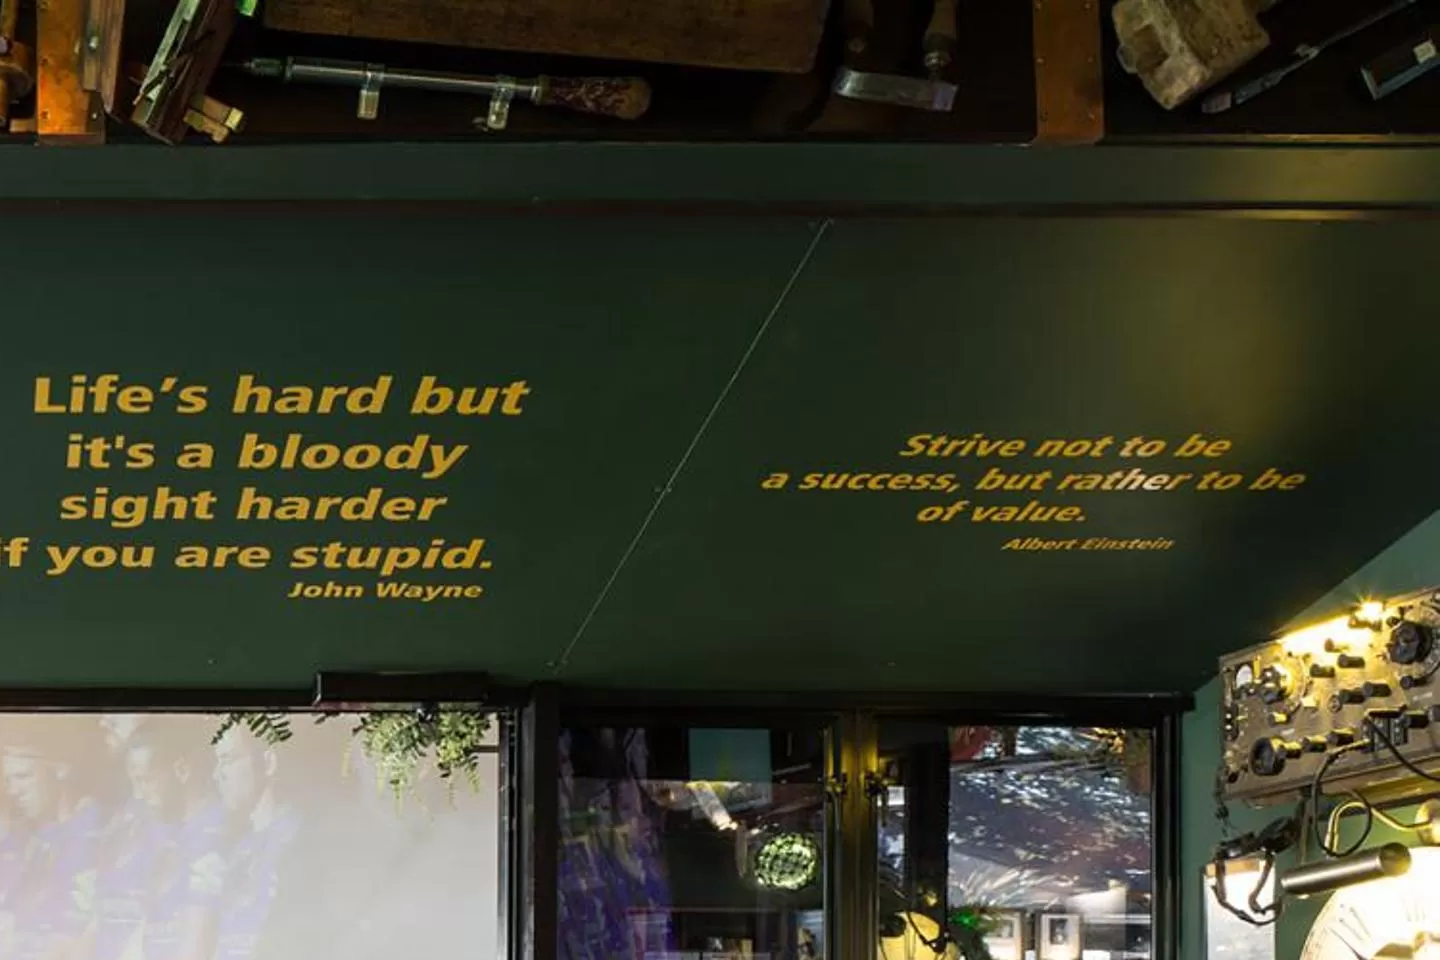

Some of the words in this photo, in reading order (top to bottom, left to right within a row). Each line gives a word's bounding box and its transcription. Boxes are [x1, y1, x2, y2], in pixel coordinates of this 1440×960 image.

[231, 374, 393, 416] hard
[410, 375, 530, 417] but
[66, 433, 155, 470] it's
[176, 442, 215, 470] a
[238, 432, 469, 480] bloody
[900, 432, 1026, 458] Strive
[1033, 435, 1118, 459] not
[1117, 434, 1168, 458] to
[1173, 432, 1234, 459] be
[760, 471, 791, 490] a
[799, 471, 960, 494] success,
[975, 466, 1054, 492] but
[1056, 467, 1193, 492] rather
[1196, 471, 1245, 492] to
[1249, 467, 1306, 492] be
[60, 486, 217, 529] sight
[235, 487, 448, 522] harder
[916, 499, 967, 524] of
[970, 499, 1087, 523] value.
[46, 543, 156, 577] you
[176, 543, 273, 570] are
[290, 537, 494, 578] stupid.
[1001, 537, 1077, 551] Albert
[1080, 537, 1174, 552] Einstein
[289, 581, 365, 600] John
[375, 582, 484, 603] Wayne
